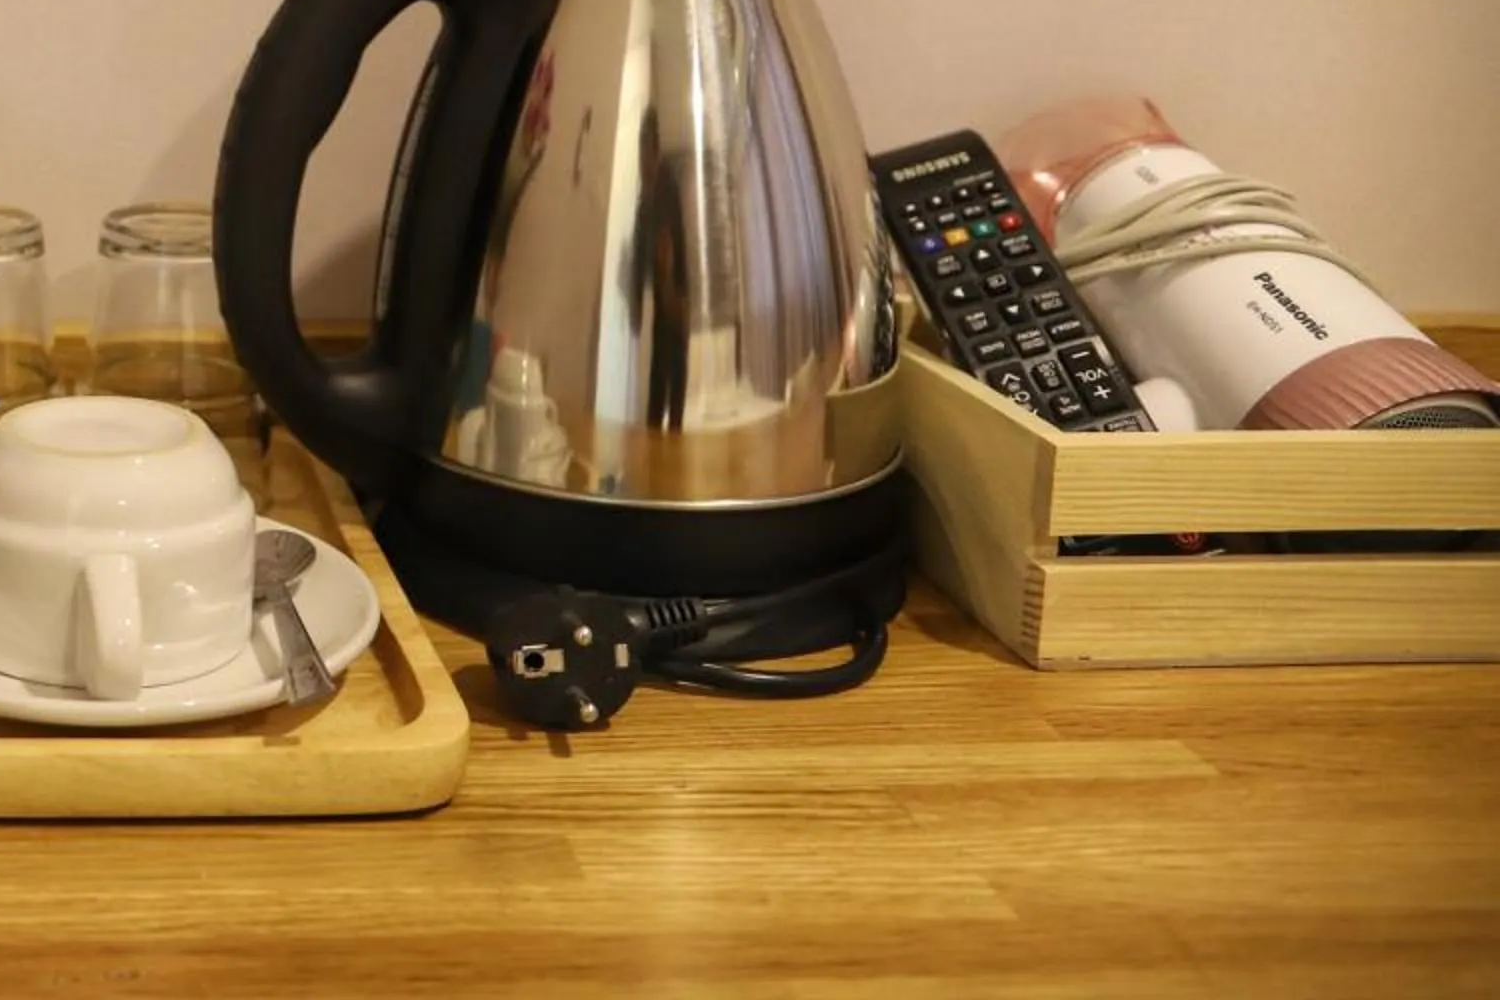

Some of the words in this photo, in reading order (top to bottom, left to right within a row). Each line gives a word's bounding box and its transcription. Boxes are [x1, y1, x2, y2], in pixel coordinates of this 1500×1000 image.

[892, 151, 970, 182] SAMSUNG
[1253, 271, 1329, 341] Panasonic
[1076, 367, 1108, 383] VOL
